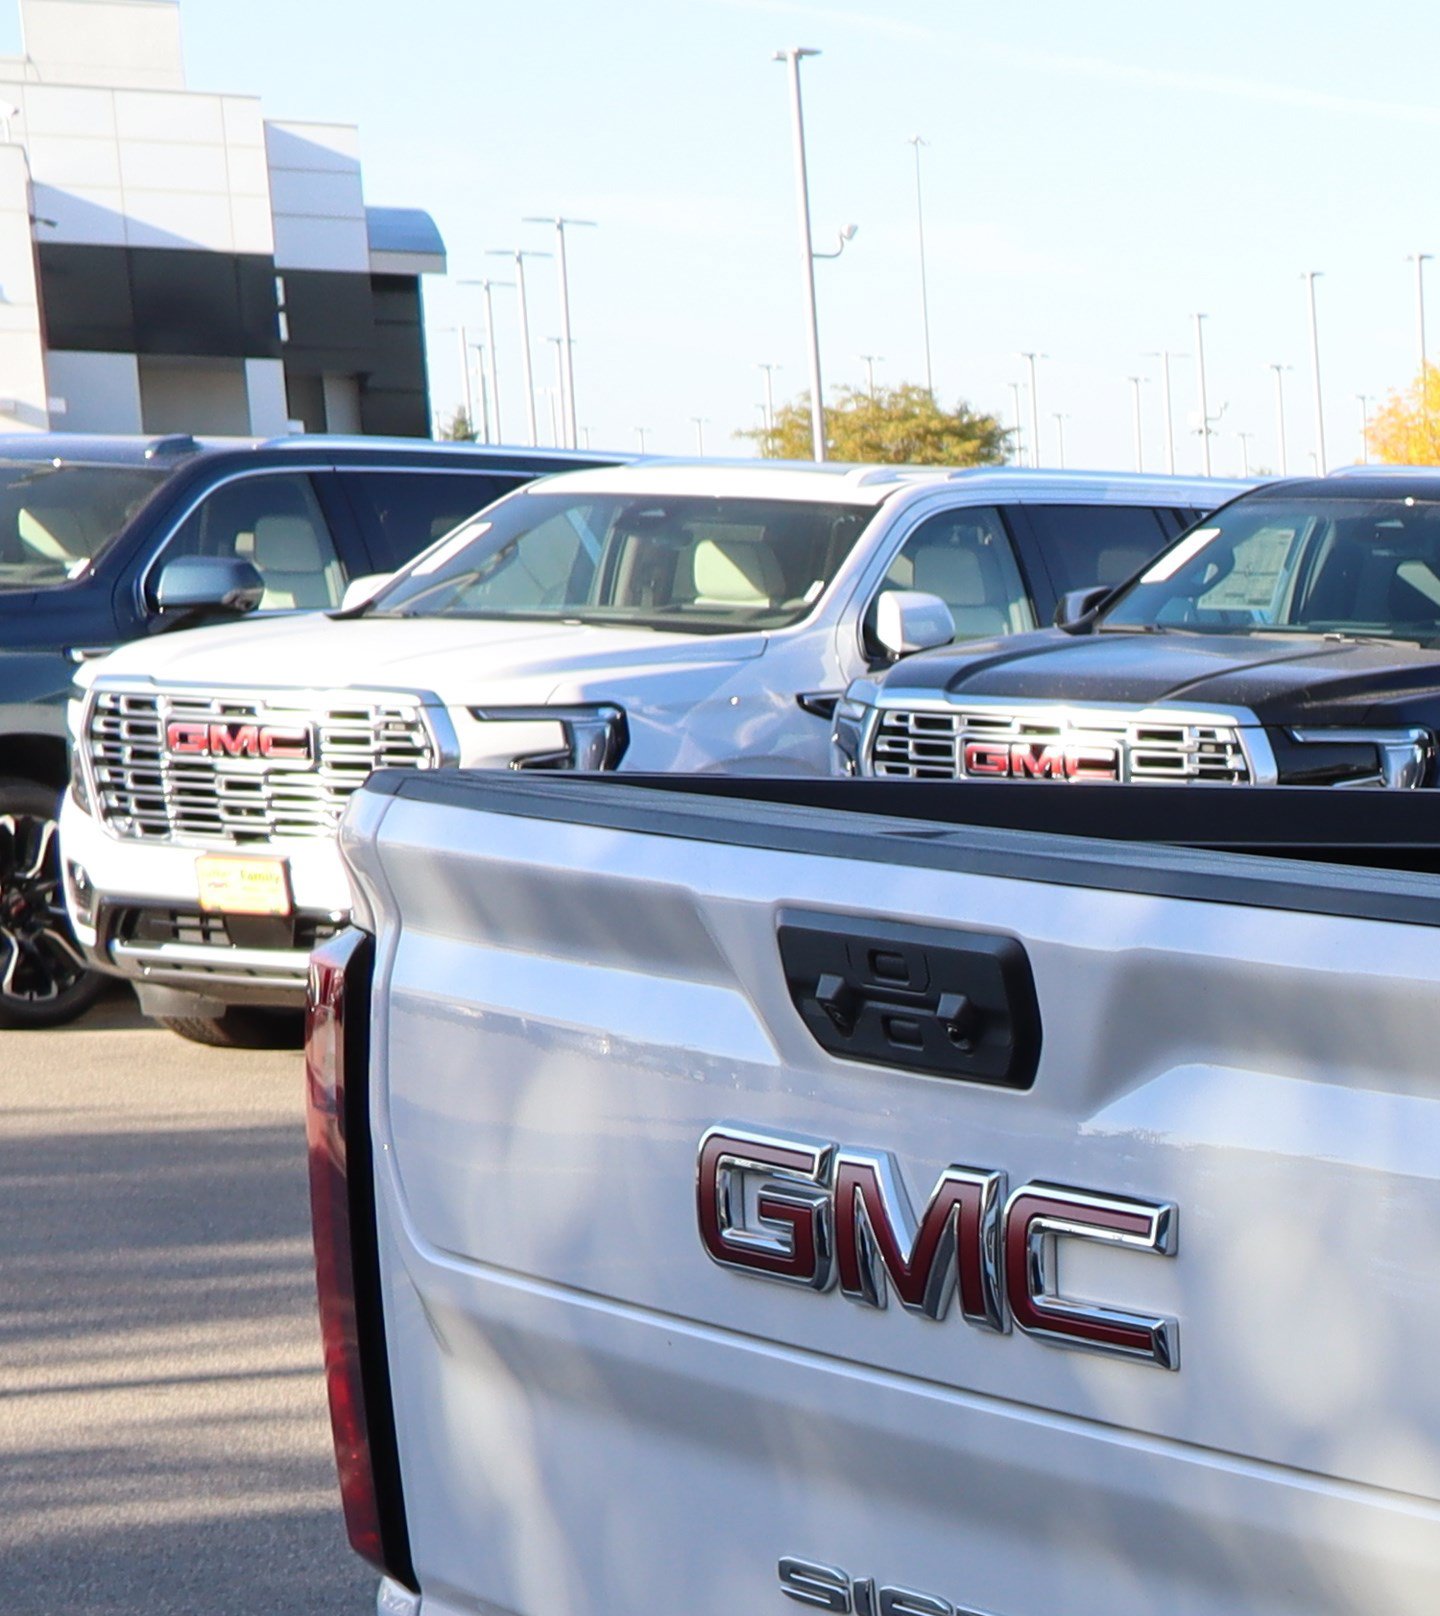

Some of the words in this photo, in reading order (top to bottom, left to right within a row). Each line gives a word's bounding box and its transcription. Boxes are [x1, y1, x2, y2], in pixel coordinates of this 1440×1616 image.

[166, 722, 309, 759] GMC
[964, 741, 1117, 783] GMC
[696, 1119, 1180, 1371] GMC
